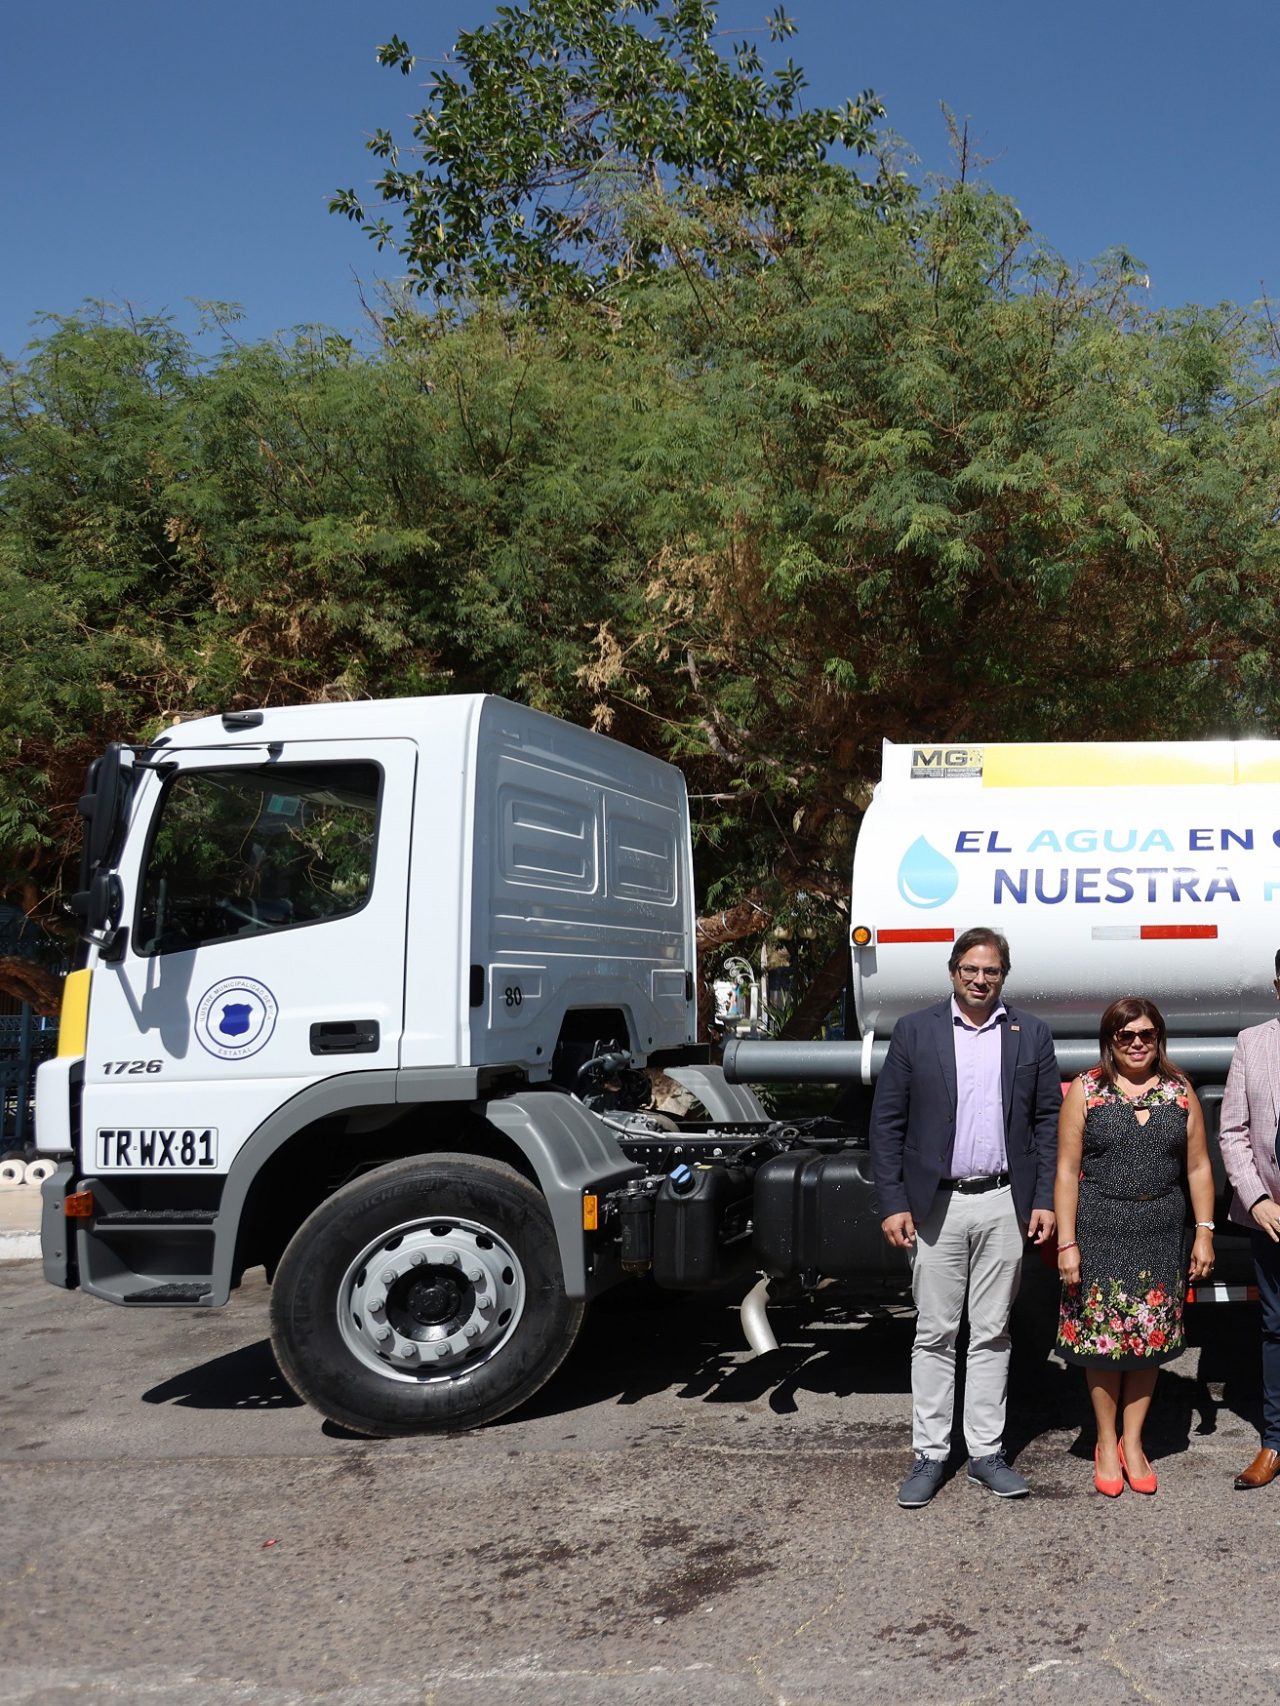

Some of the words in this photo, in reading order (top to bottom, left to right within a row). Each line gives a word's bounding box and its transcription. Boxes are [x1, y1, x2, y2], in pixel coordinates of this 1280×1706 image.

[955, 831, 1012, 853] EL
[1026, 829, 1175, 852] AGUA
[1189, 829, 1254, 851] EN
[993, 867, 1240, 904] NUESTRA
[200, 996, 213, 1021] ILUSTRE
[213, 981, 264, 995] MUNICIPALIDAD
[505, 986, 522, 1007] 80
[103, 1060, 164, 1075] 1726
